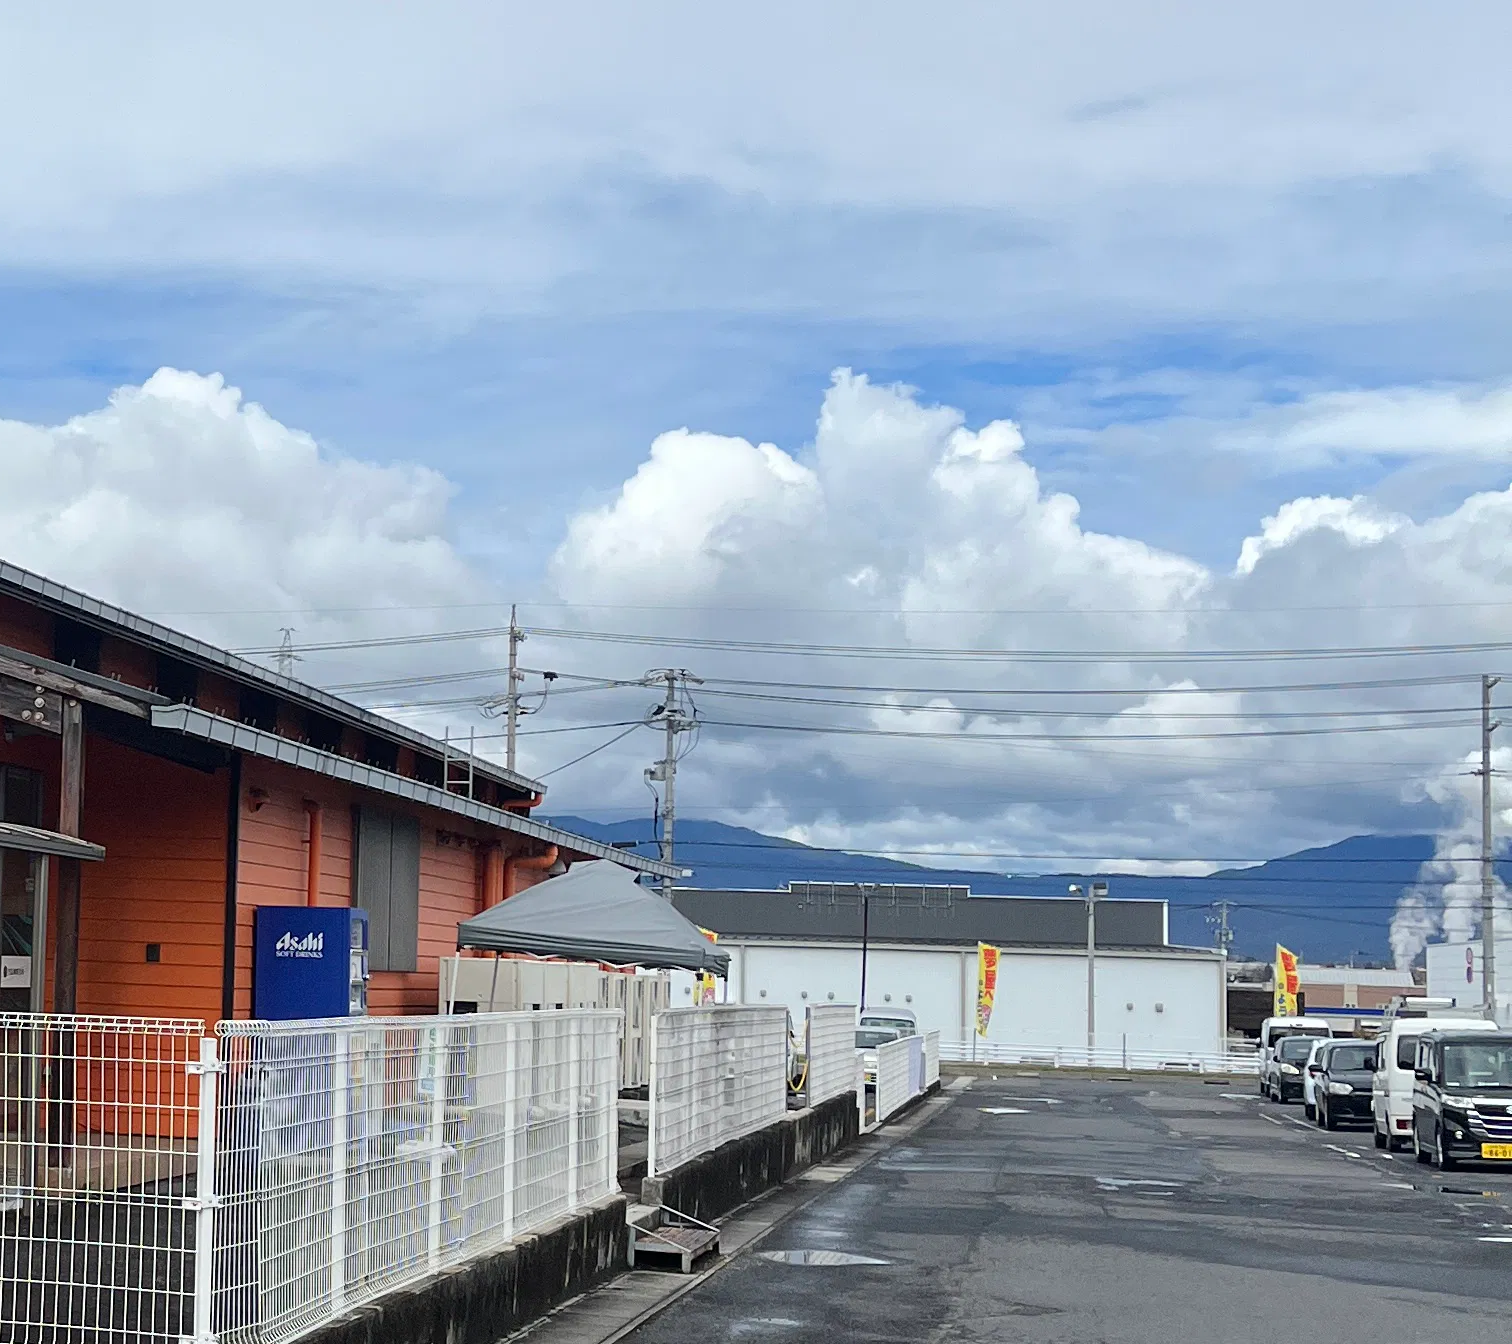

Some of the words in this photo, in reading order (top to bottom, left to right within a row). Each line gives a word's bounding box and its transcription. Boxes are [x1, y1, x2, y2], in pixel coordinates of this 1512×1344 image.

[275, 931, 323, 951] Asahi
[275, 950, 294, 958] SOFT
[295, 950, 323, 958] DRINKS
